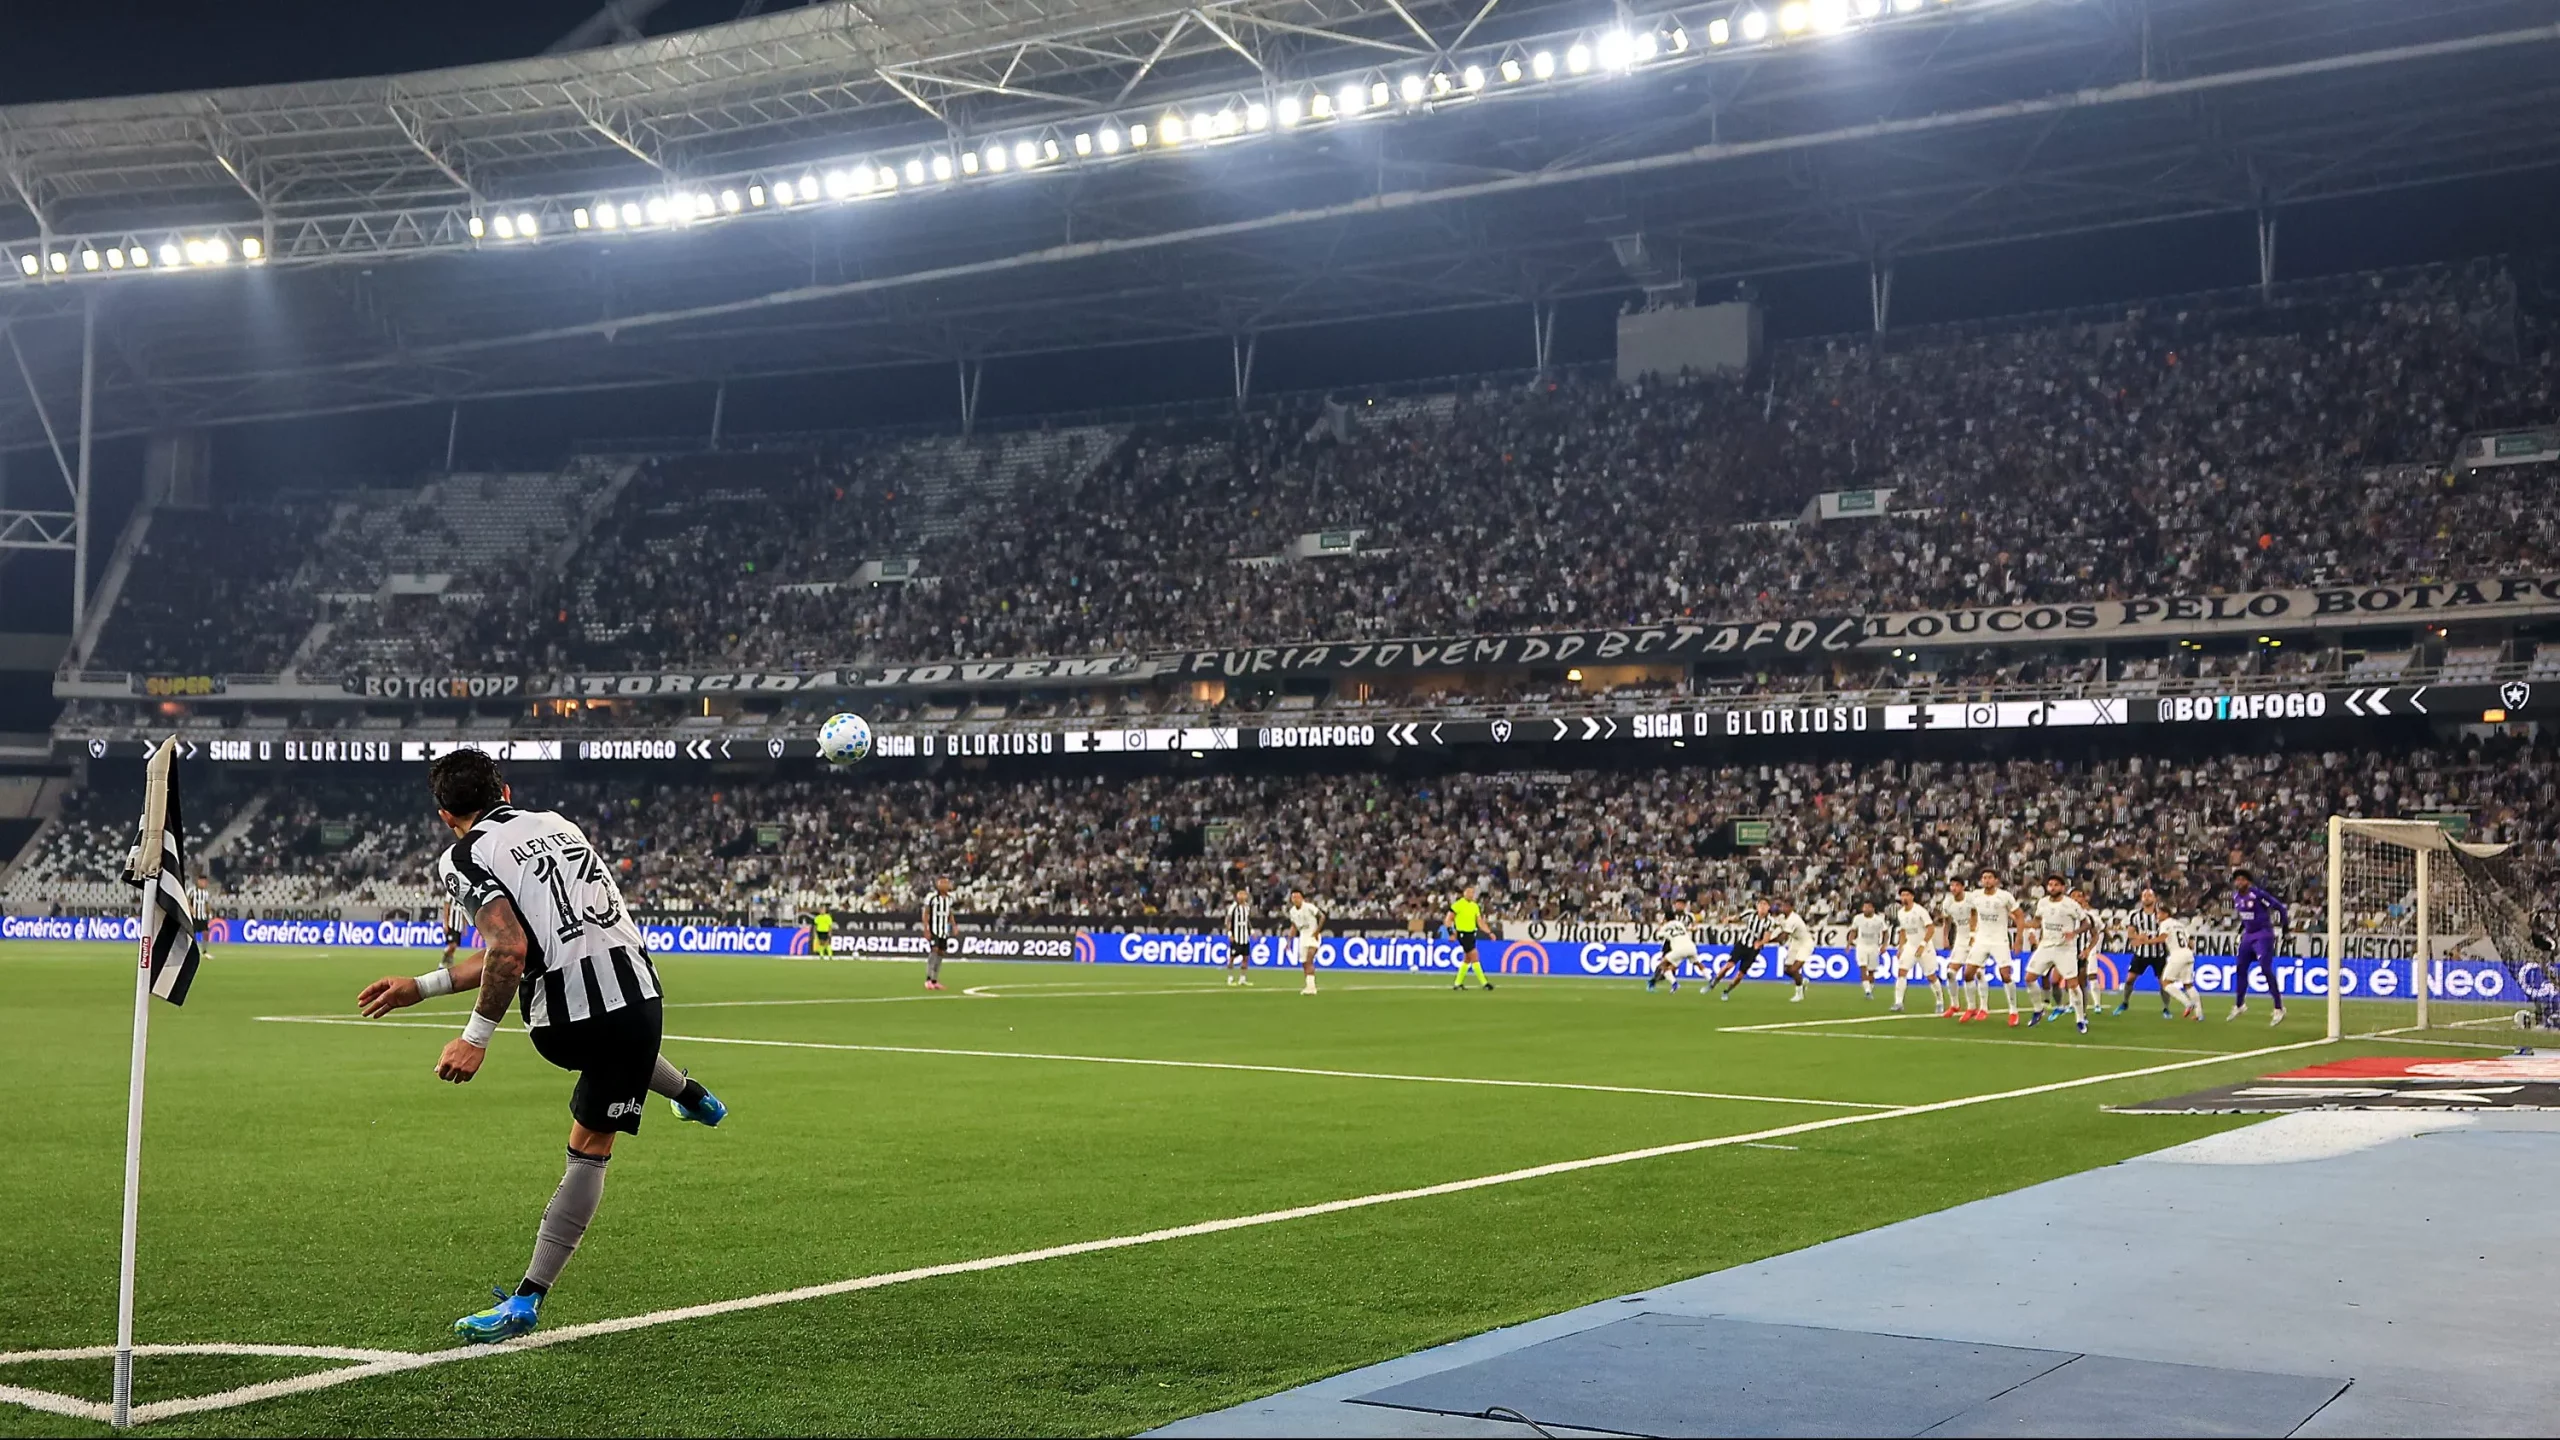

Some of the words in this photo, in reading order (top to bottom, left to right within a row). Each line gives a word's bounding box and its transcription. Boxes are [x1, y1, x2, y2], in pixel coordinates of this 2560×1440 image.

[1866, 605, 2098, 638] LOUCOS
[2119, 592, 2291, 625] PELO
[1191, 646, 1330, 677] FURIA
[1339, 638, 1508, 668] JOVEM
[146, 676, 212, 696] SUPER
[365, 676, 519, 698] BOTACHOPP
[580, 670, 837, 696] TORCIDA
[865, 656, 1121, 688] JOVEM
[2156, 691, 2327, 724] @BOTAFOGO
[1258, 724, 1375, 748] @BOTAFOGO
[1632, 713, 1683, 739] SIGA
[1694, 712, 1708, 737] O
[1726, 706, 1868, 737] GLORIOSO
[209, 740, 251, 761] SIGA
[259, 740, 271, 760] O
[284, 740, 391, 761] GLORIOSO
[579, 740, 677, 760] @BOTAFOGO
[876, 735, 915, 757] SIGA
[923, 734, 934, 757] O
[947, 732, 1052, 756] GLORIOSO
[510, 837, 553, 867] ALEX
[533, 847, 622, 945] 13
[2, 916, 72, 940] Genérico
[74, 917, 87, 940] é
[88, 917, 120, 940] Neo
[243, 918, 320, 944] Genérico
[322, 921, 335, 945] é
[338, 921, 374, 946] Neo
[678, 924, 772, 952] Química
[830, 935, 959, 954] BRASILEIRO
[961, 935, 1020, 955] Betano
[1022, 939, 1072, 957] 2026
[1251, 936, 1270, 966] é
[1276, 936, 1337, 967] No
[2368, 960, 2398, 997] é
